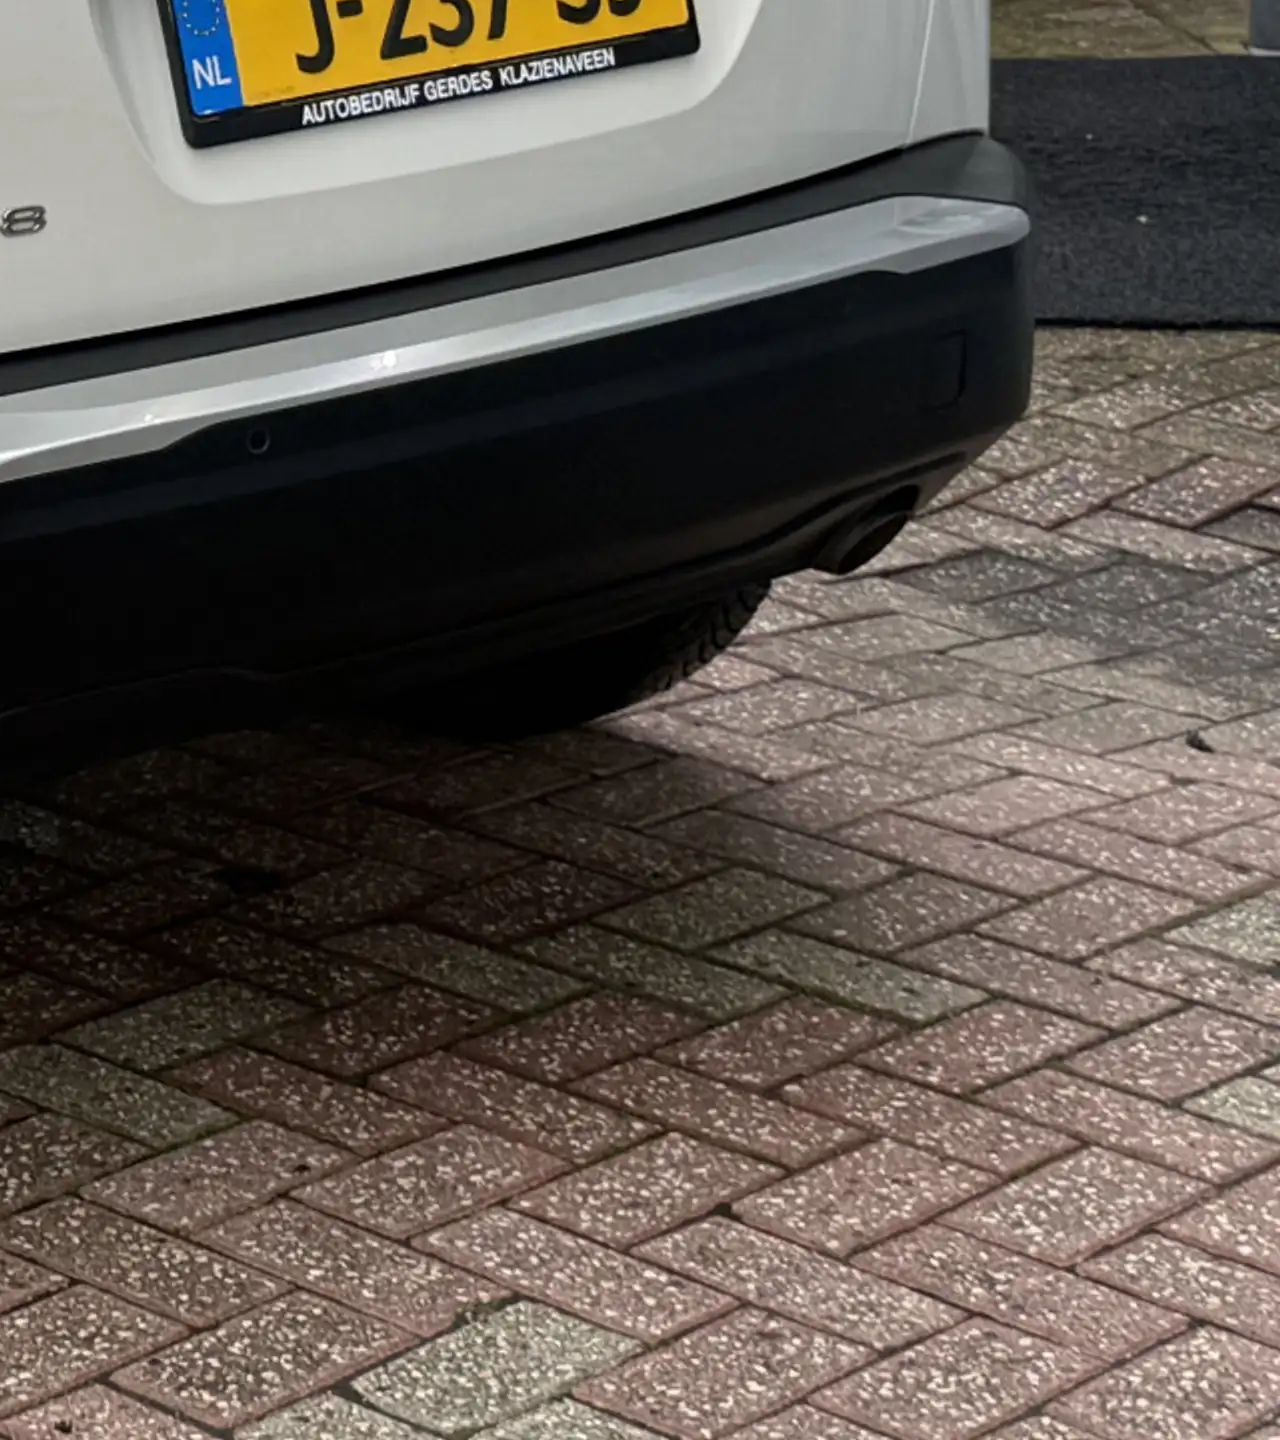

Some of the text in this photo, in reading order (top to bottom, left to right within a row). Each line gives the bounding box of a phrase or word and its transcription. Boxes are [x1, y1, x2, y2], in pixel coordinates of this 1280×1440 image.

[192, 57, 232, 89] NL
[301, 46, 615, 126] AUTOBEDRIJF GERDES KLAZIENAVEEN
